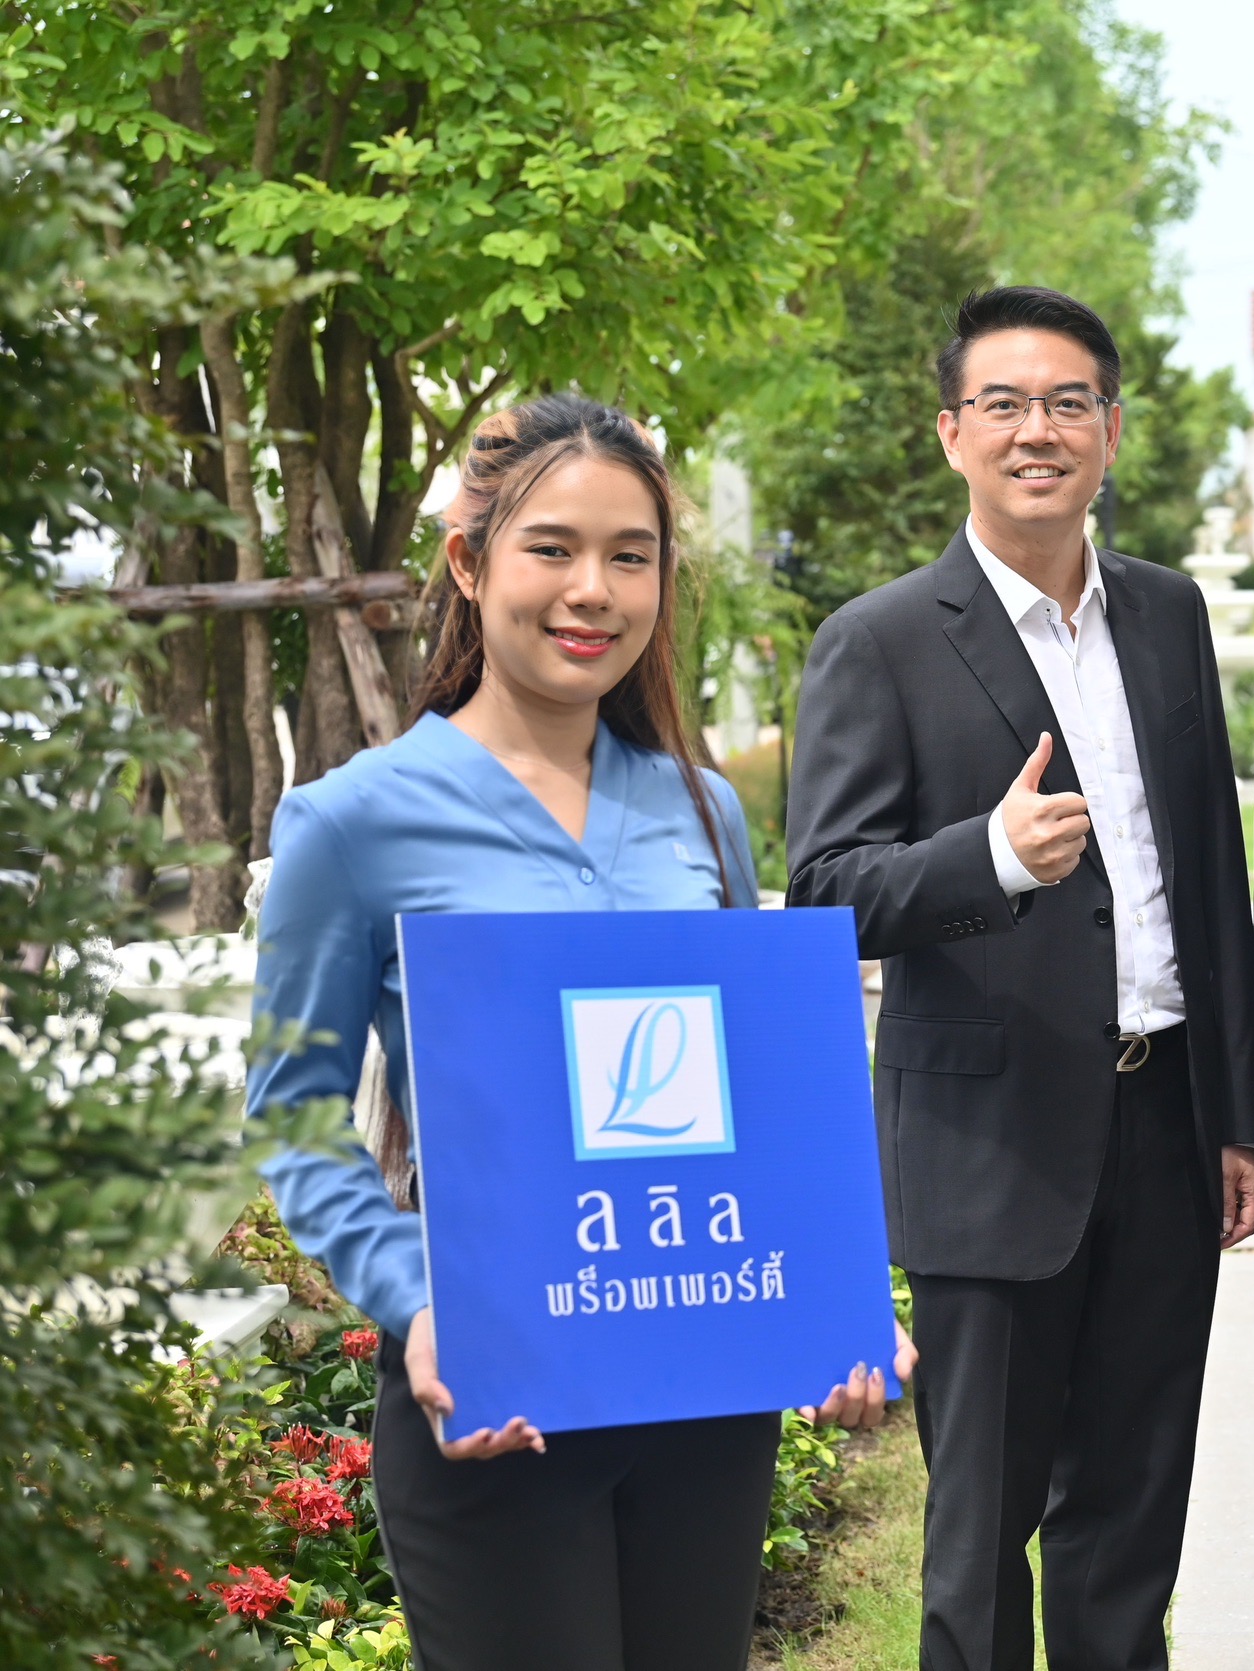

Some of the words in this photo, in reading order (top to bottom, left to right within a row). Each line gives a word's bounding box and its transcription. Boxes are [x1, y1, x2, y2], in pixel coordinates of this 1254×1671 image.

[545, 1250, 786, 1317] พร็อพเพอร์ตี้
